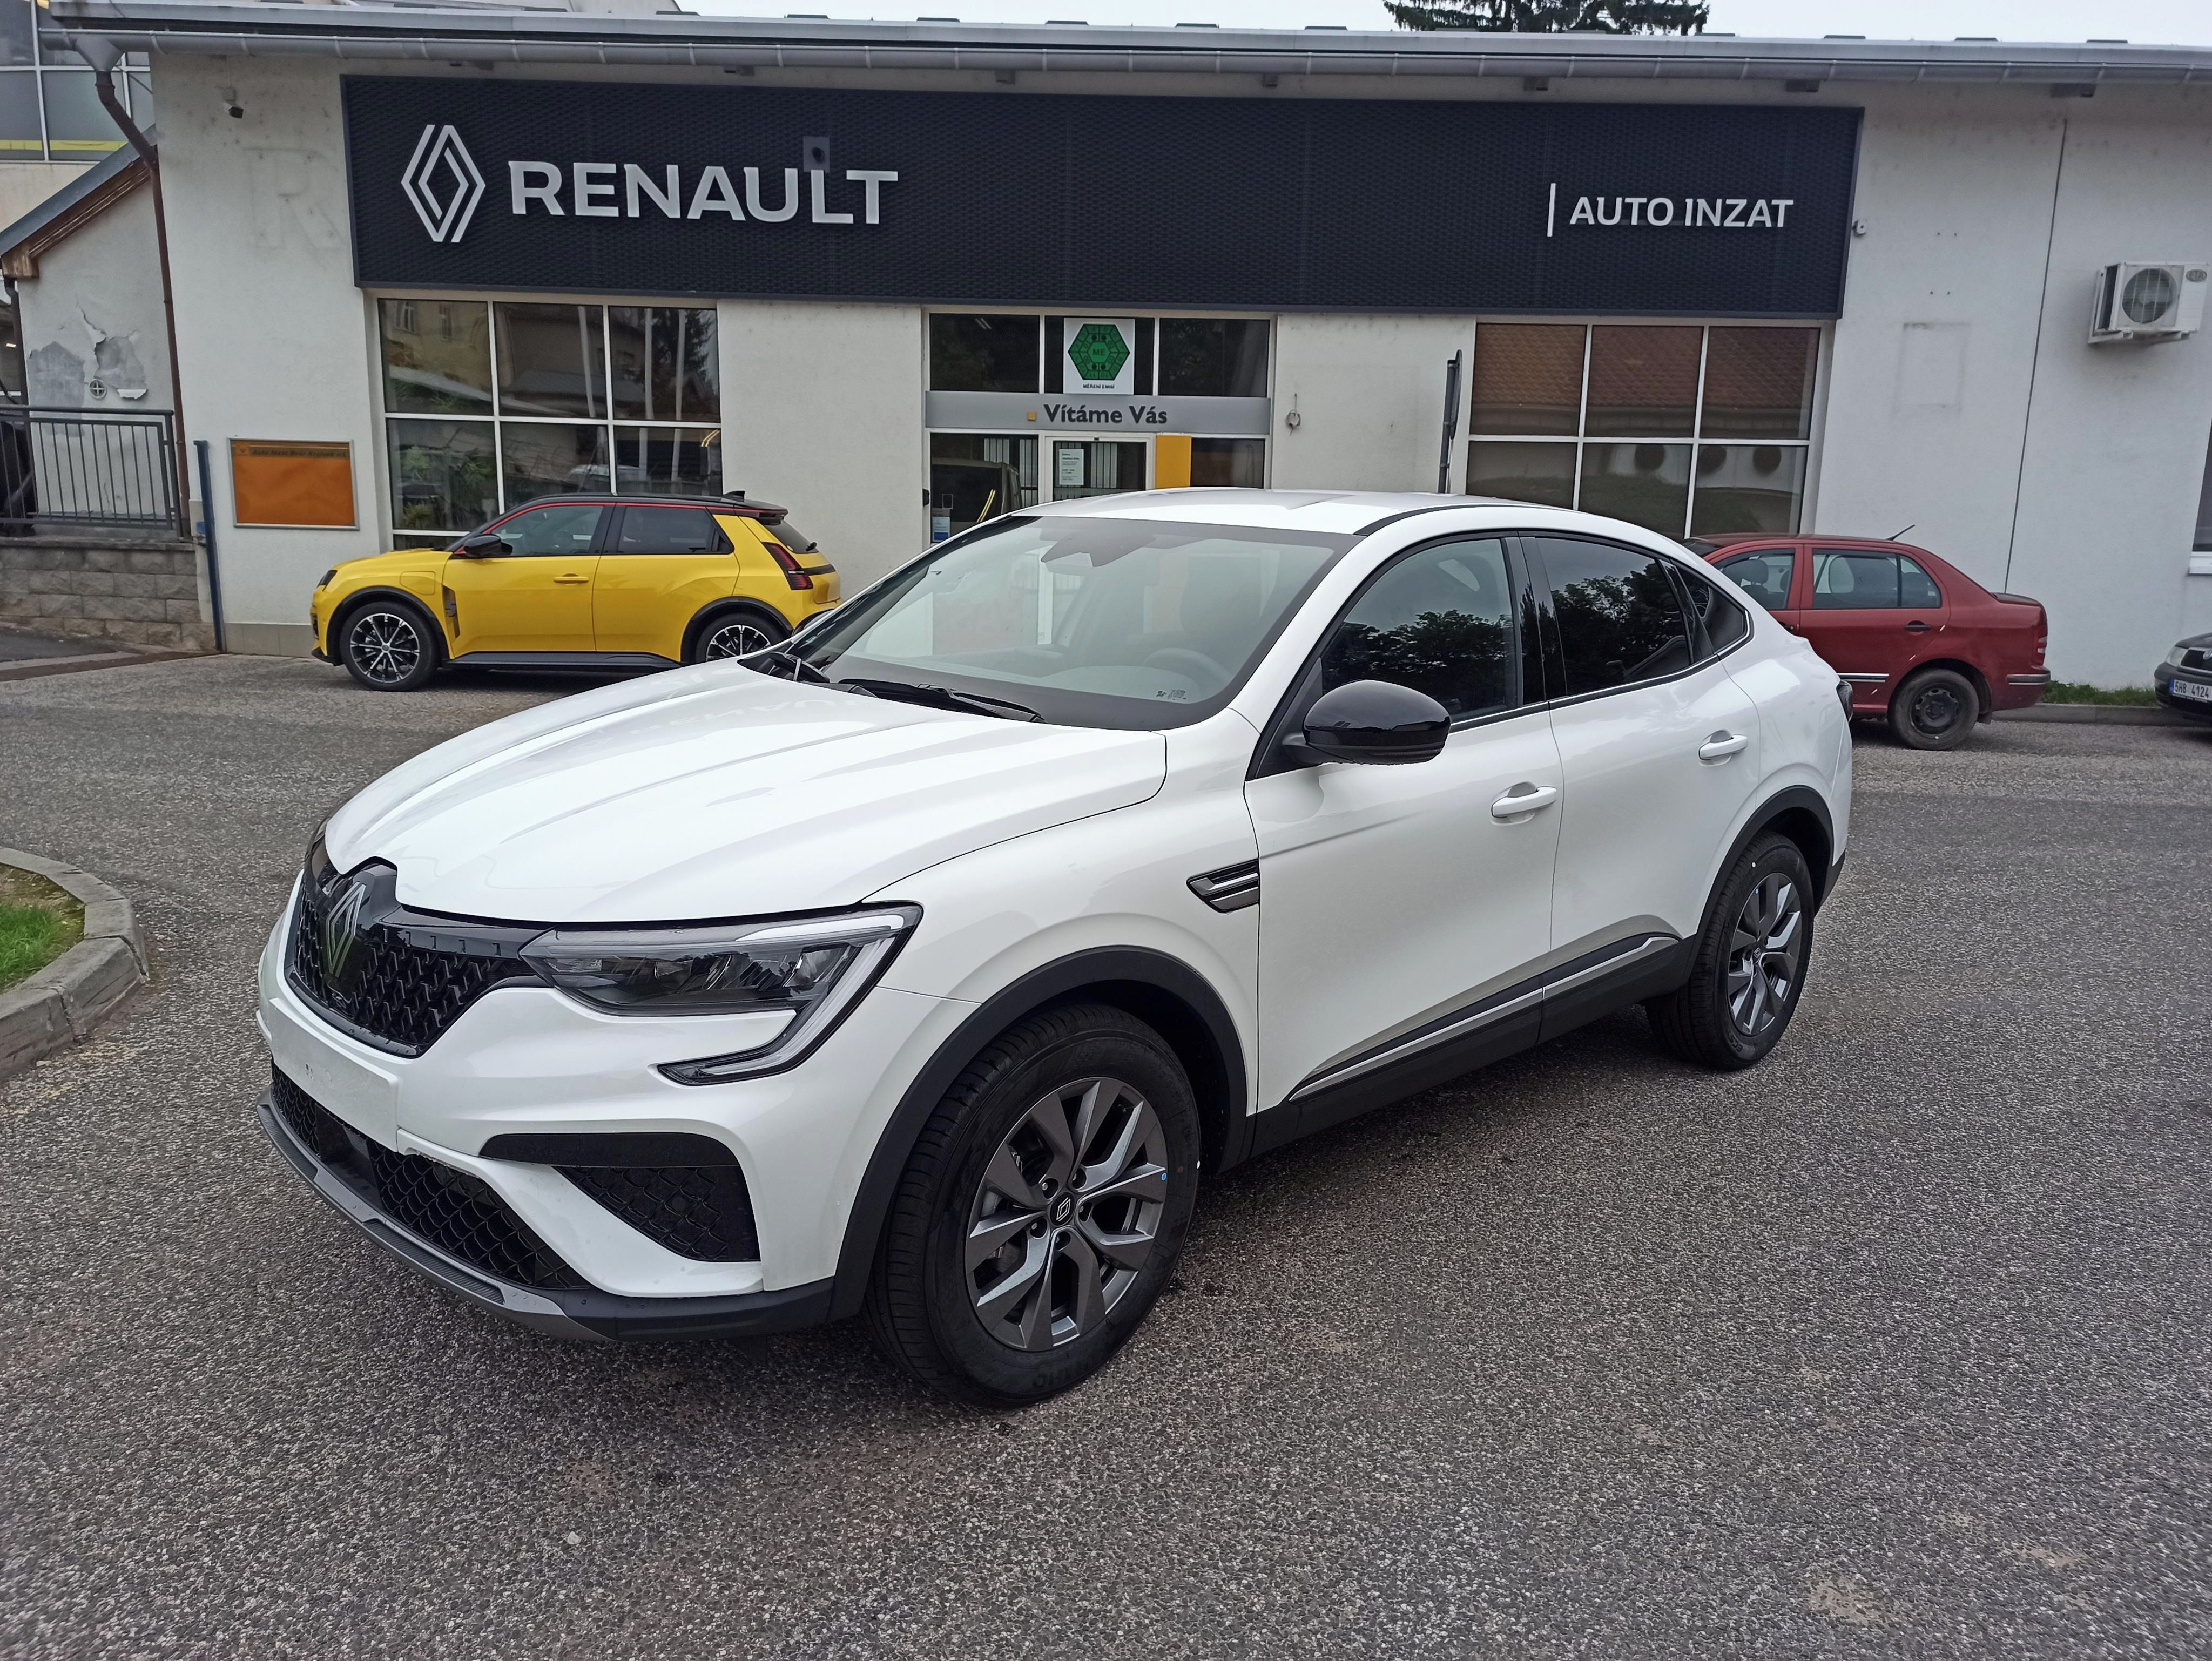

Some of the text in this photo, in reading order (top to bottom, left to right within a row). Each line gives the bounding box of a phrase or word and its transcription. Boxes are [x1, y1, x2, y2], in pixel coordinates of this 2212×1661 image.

[508, 161, 898, 224] RENAULT
[1569, 197, 1794, 227] AUTO INZAT
[1043, 404, 1168, 424] Vítáme Vás
[2175, 681, 2209, 698] 5H8 4124
